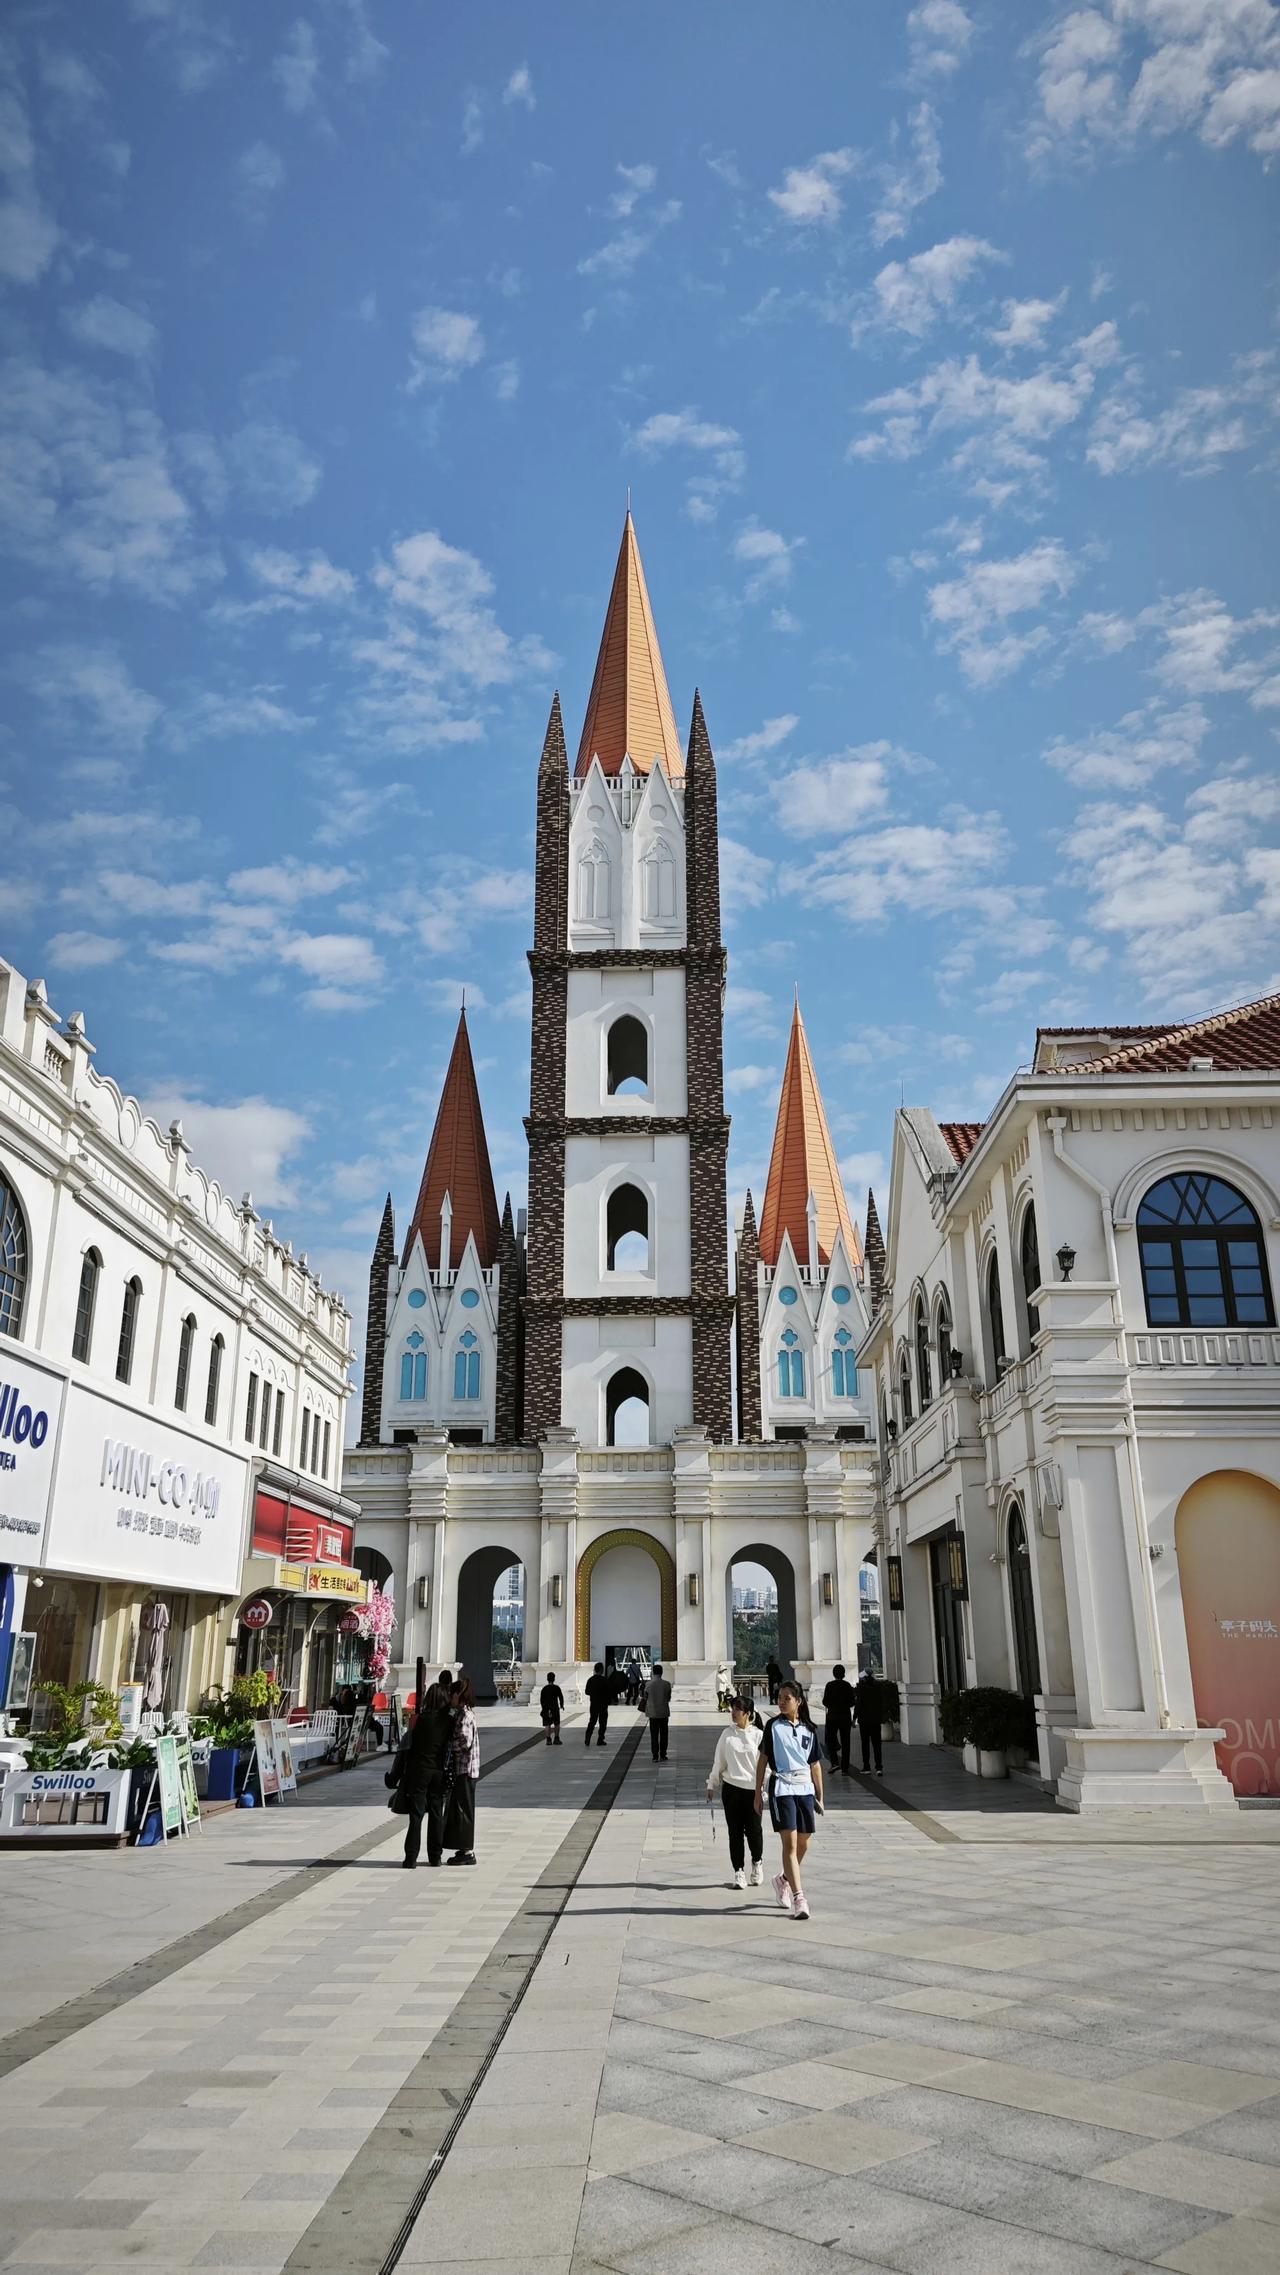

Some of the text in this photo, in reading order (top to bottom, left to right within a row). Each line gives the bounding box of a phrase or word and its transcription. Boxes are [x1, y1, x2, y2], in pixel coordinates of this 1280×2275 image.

[0, 1383, 48, 1449] lloo
[1220, 1620, 1277, 1633] 亭子码头
[31, 1774, 96, 1790] Swilloo
